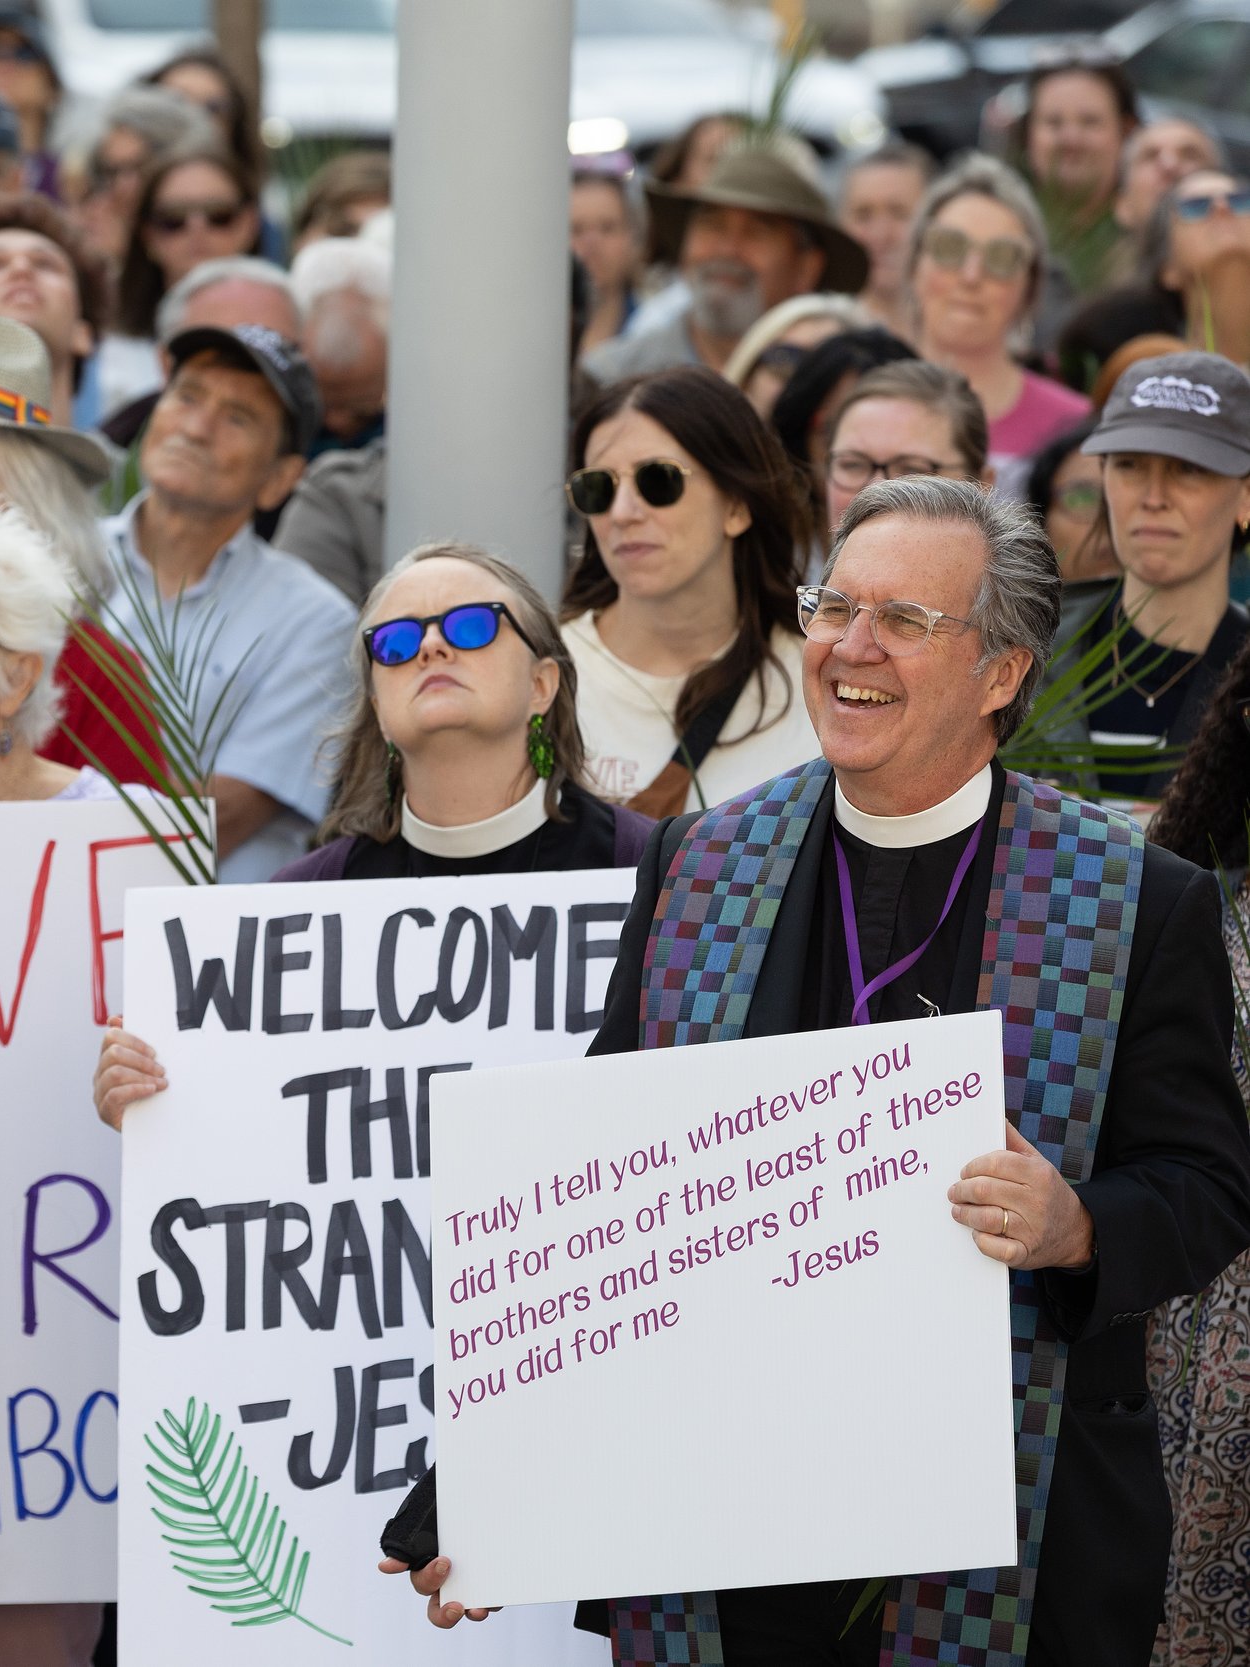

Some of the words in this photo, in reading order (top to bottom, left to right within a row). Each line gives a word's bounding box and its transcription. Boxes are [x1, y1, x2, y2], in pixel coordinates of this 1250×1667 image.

[164, 903, 631, 1035] WELCOME
[445, 1198, 523, 1247] Truly
[534, 1183, 542, 1214] I
[550, 1160, 601, 1207] tell
[609, 1139, 678, 1193] you,
[688, 1072, 842, 1152] whatever
[853, 1044, 910, 1095] you
[450, 1259, 495, 1303] did
[503, 1244, 556, 1283] for
[567, 1219, 623, 1259] one
[636, 1192, 669, 1232] of
[680, 1176, 735, 1216] the
[747, 1133, 825, 1191] least
[838, 1113, 871, 1154] of
[886, 1073, 982, 1131] these
[450, 1286, 590, 1360] brothers
[600, 1250, 658, 1300] and
[669, 1213, 779, 1274] sisters
[790, 1186, 823, 1226] of
[846, 1150, 927, 1200] mine,
[772, 1231, 879, 1287] -Jesus
[447, 1369, 506, 1420] you
[517, 1339, 562, 1384] did
[570, 1322, 623, 1361] for
[634, 1302, 678, 1339] me
